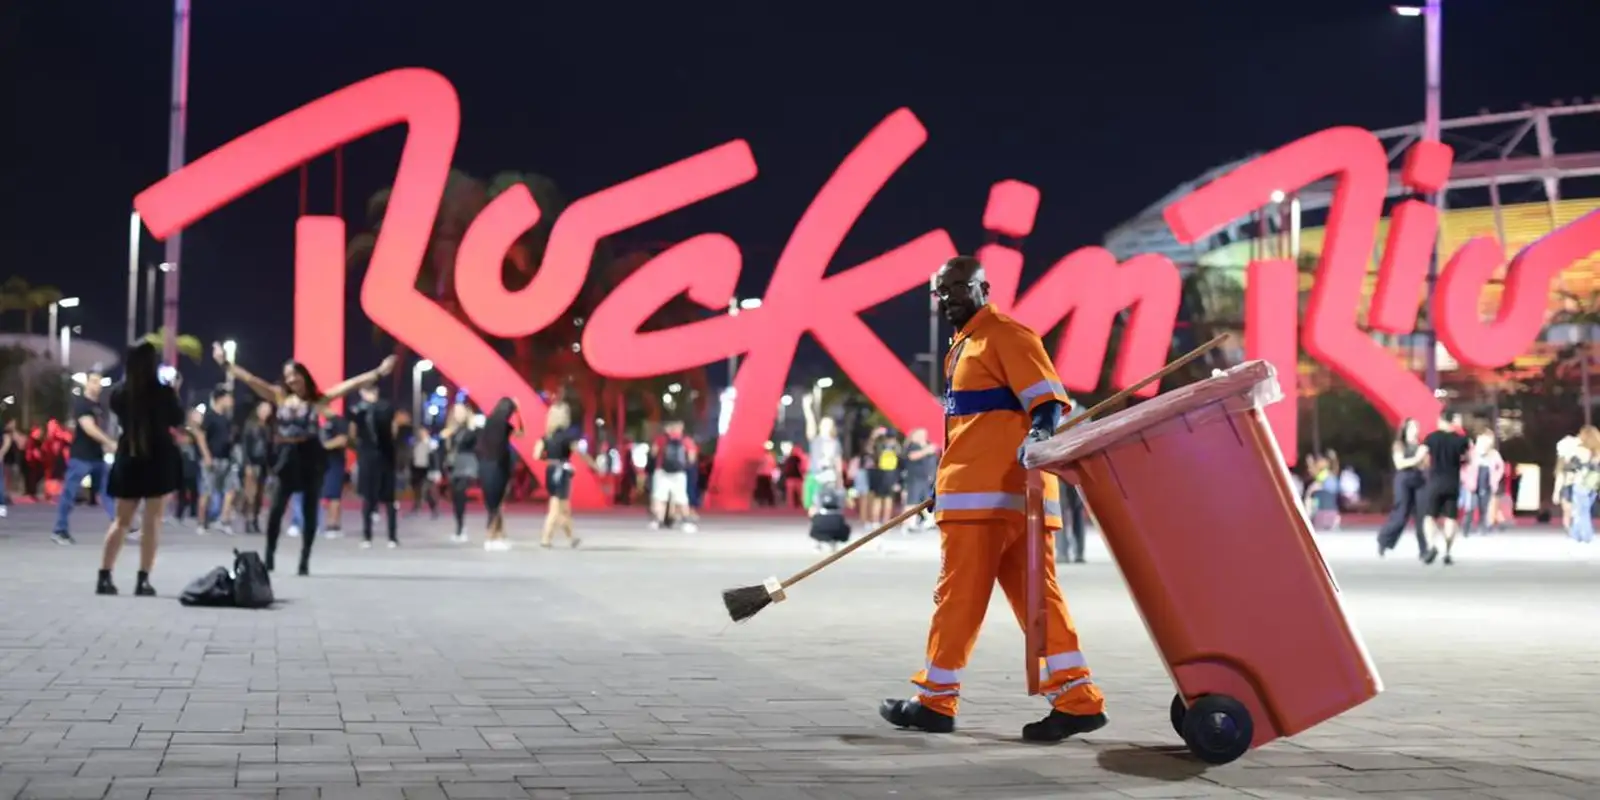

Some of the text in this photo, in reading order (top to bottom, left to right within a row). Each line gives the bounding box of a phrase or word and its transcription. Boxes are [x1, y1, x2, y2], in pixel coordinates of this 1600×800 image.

[134, 67, 1600, 510] Rock in Rio
